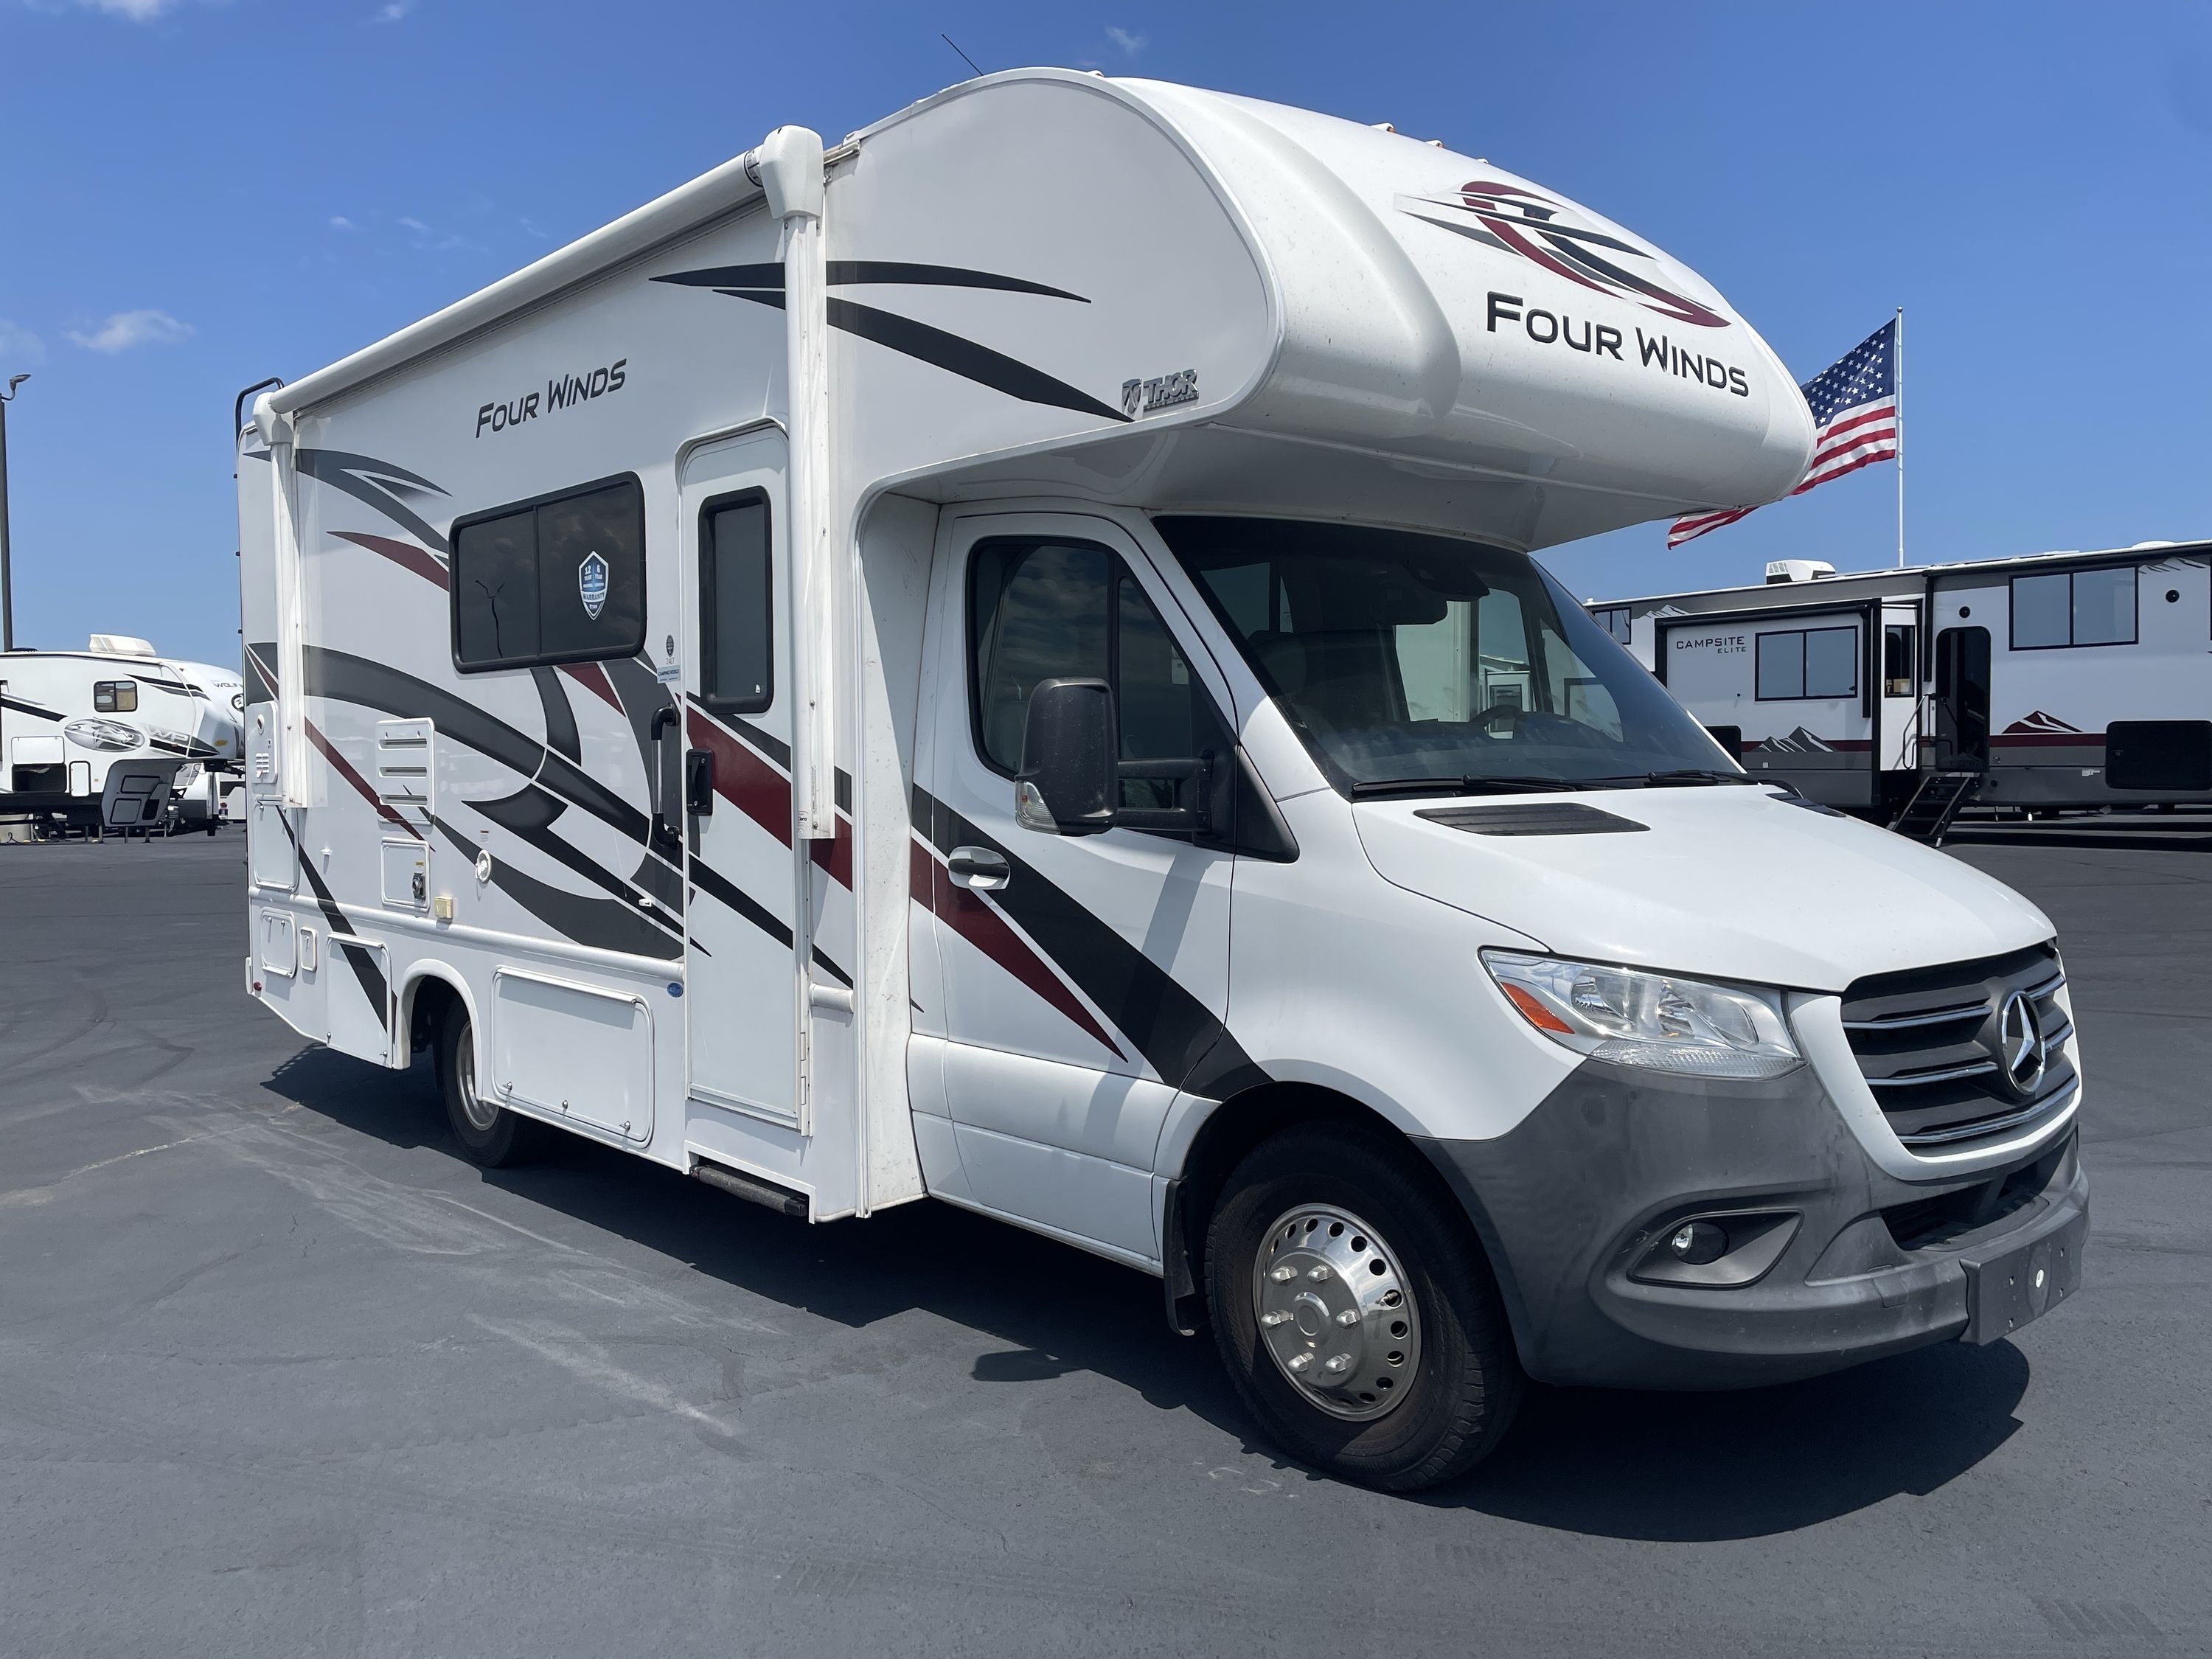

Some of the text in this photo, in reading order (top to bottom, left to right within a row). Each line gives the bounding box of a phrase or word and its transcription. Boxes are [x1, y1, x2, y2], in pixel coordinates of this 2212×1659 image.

[1486, 291, 1749, 397] FOUR WINDS
[476, 358, 627, 438] FOUR WINDS
[1144, 369, 1199, 403] THOR
[1677, 636, 1745, 649] CAMPSITE
